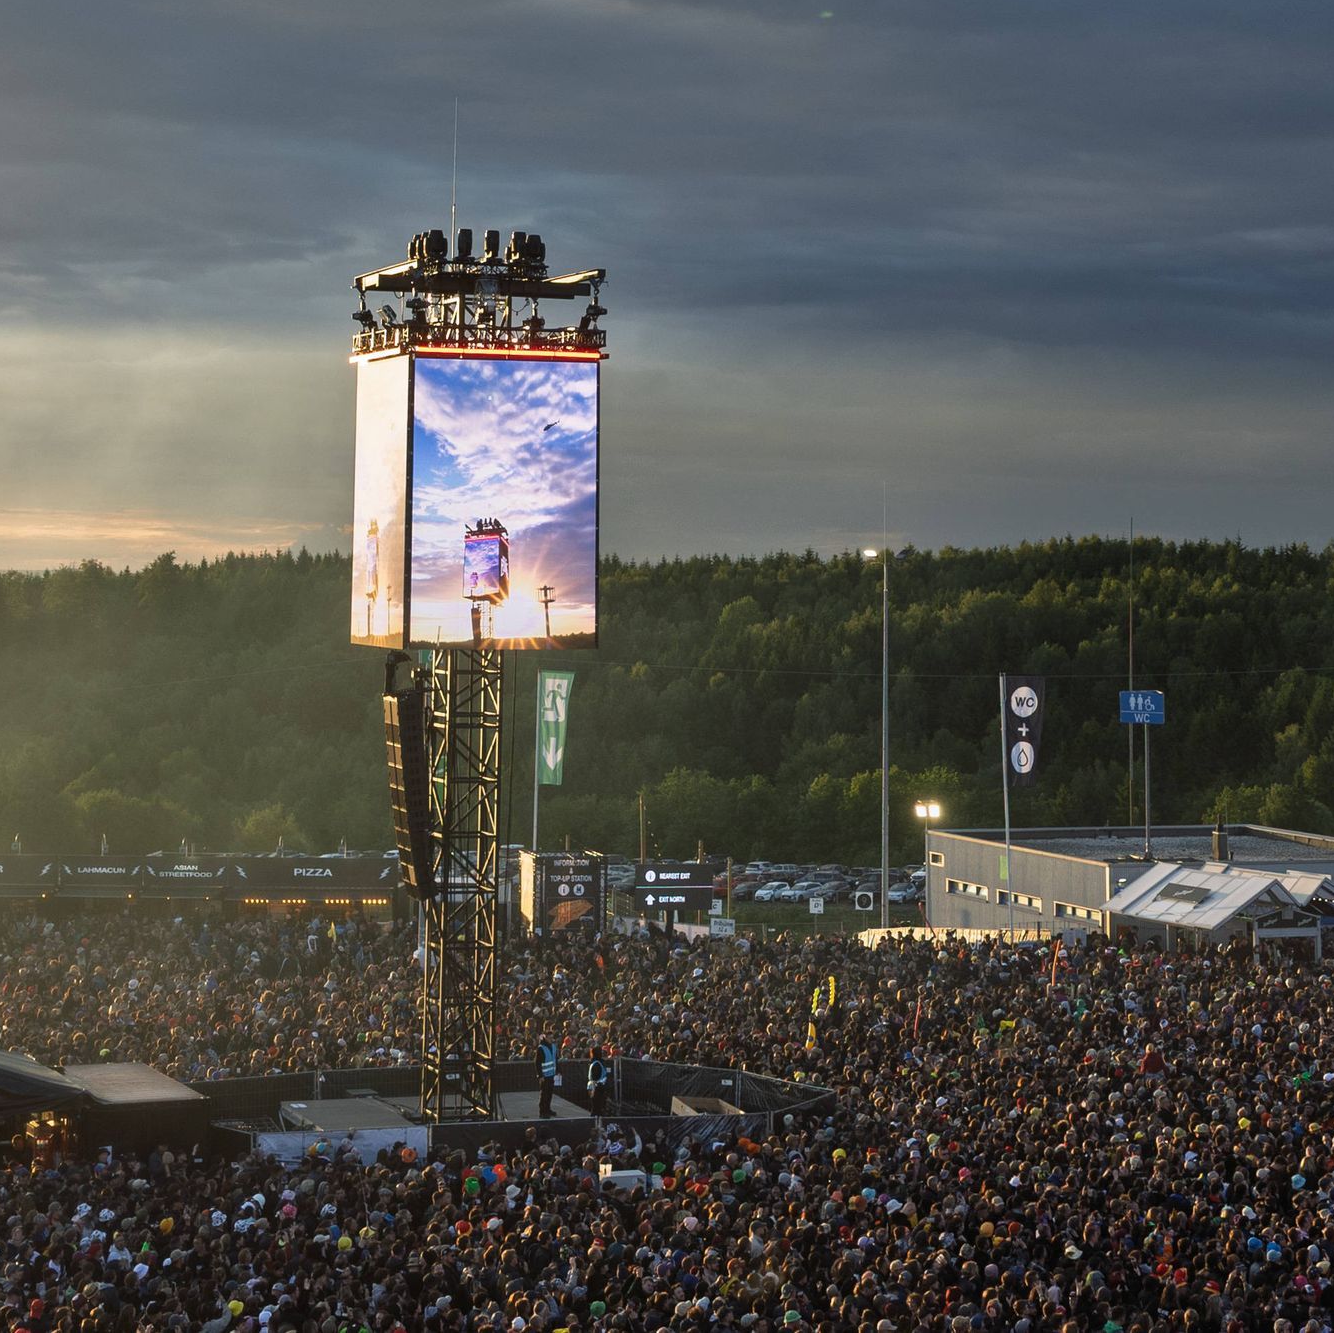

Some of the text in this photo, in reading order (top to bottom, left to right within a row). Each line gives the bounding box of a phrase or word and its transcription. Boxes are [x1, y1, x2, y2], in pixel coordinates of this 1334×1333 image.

[1015, 696, 1035, 708] WC
[1134, 713, 1151, 723] WC
[77, 866, 126, 874] LAHMACUN
[293, 867, 333, 877] PIZZA
[659, 872, 691, 880] NEAREST EXIT
